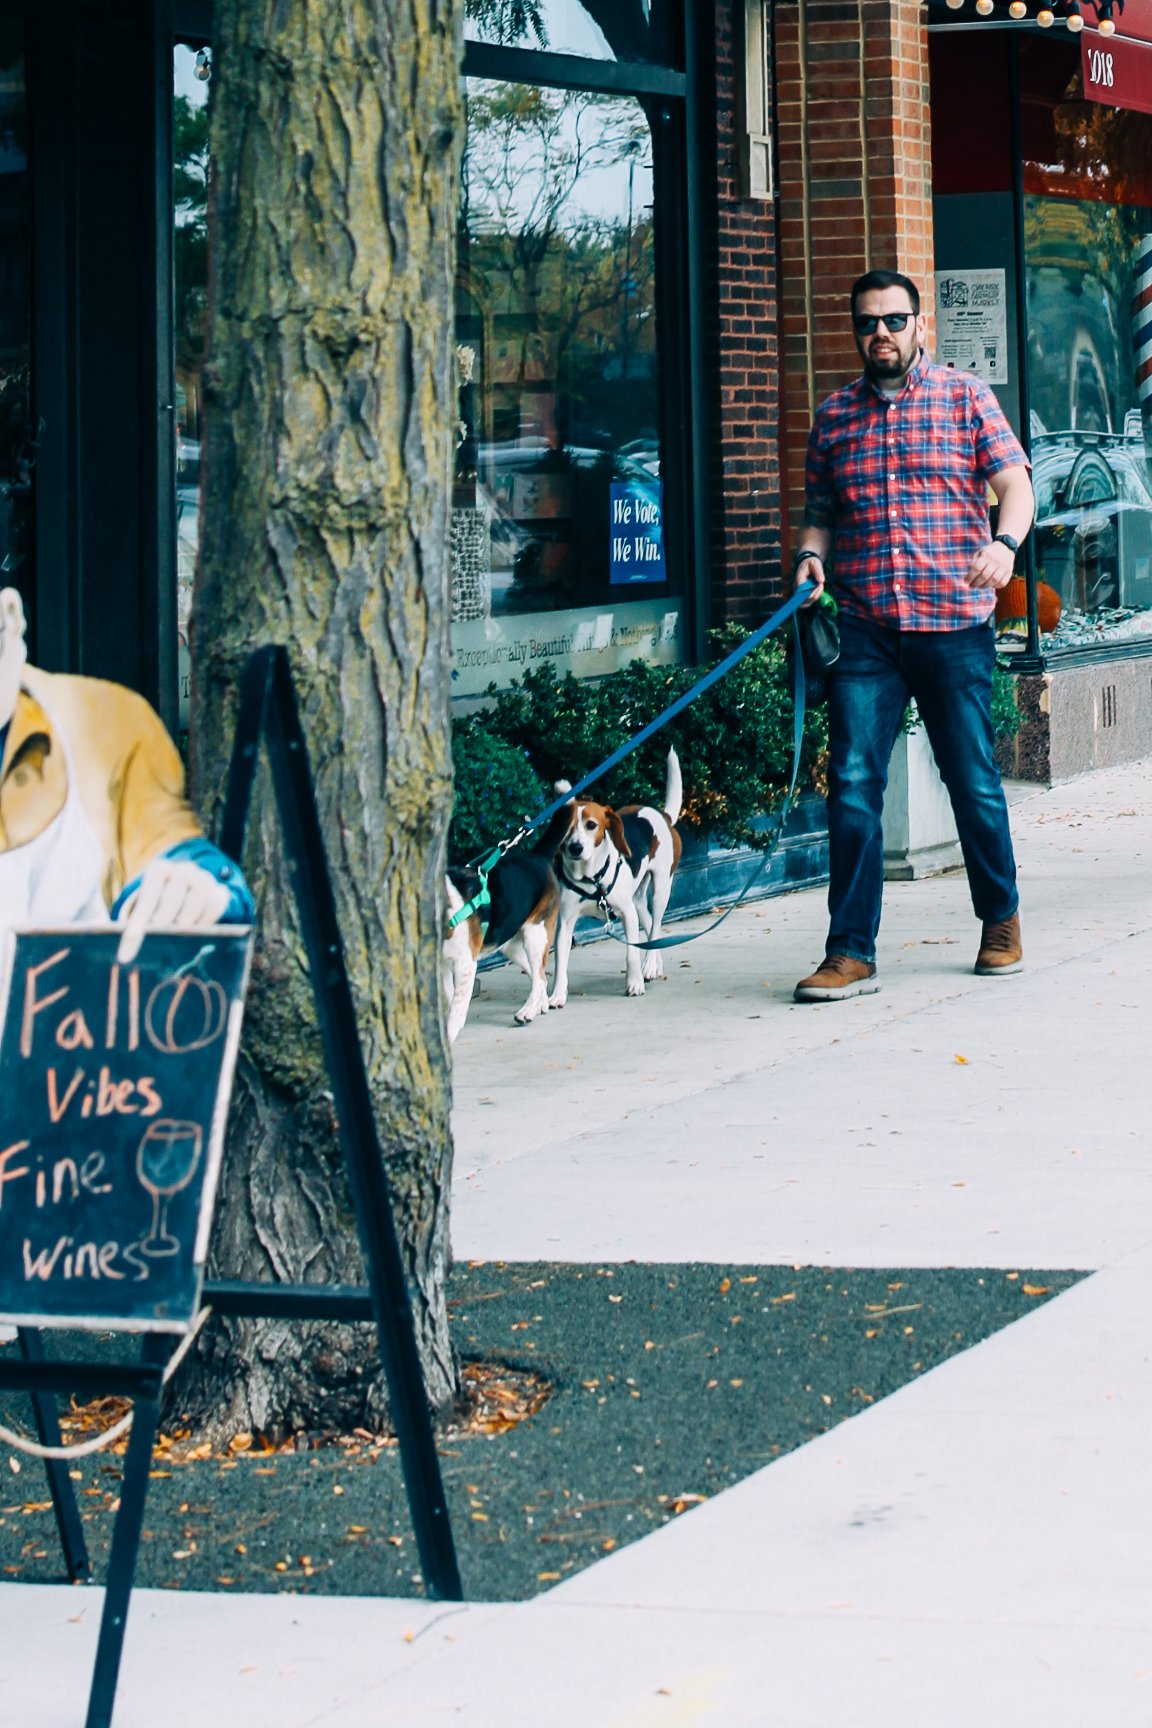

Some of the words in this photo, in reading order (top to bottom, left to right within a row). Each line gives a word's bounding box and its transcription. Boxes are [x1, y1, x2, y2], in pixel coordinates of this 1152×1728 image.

[1087, 47, 1114, 88] 1018
[613, 498, 632, 525] We
[634, 498, 659, 527] Vote,
[612, 537, 632, 563] We
[634, 536, 661, 562] Win.
[20, 947, 140, 1059] Fall
[46, 1066, 162, 1123] Vibes
[0, 1139, 113, 1209] Fine
[23, 1235, 151, 1282] Wines
